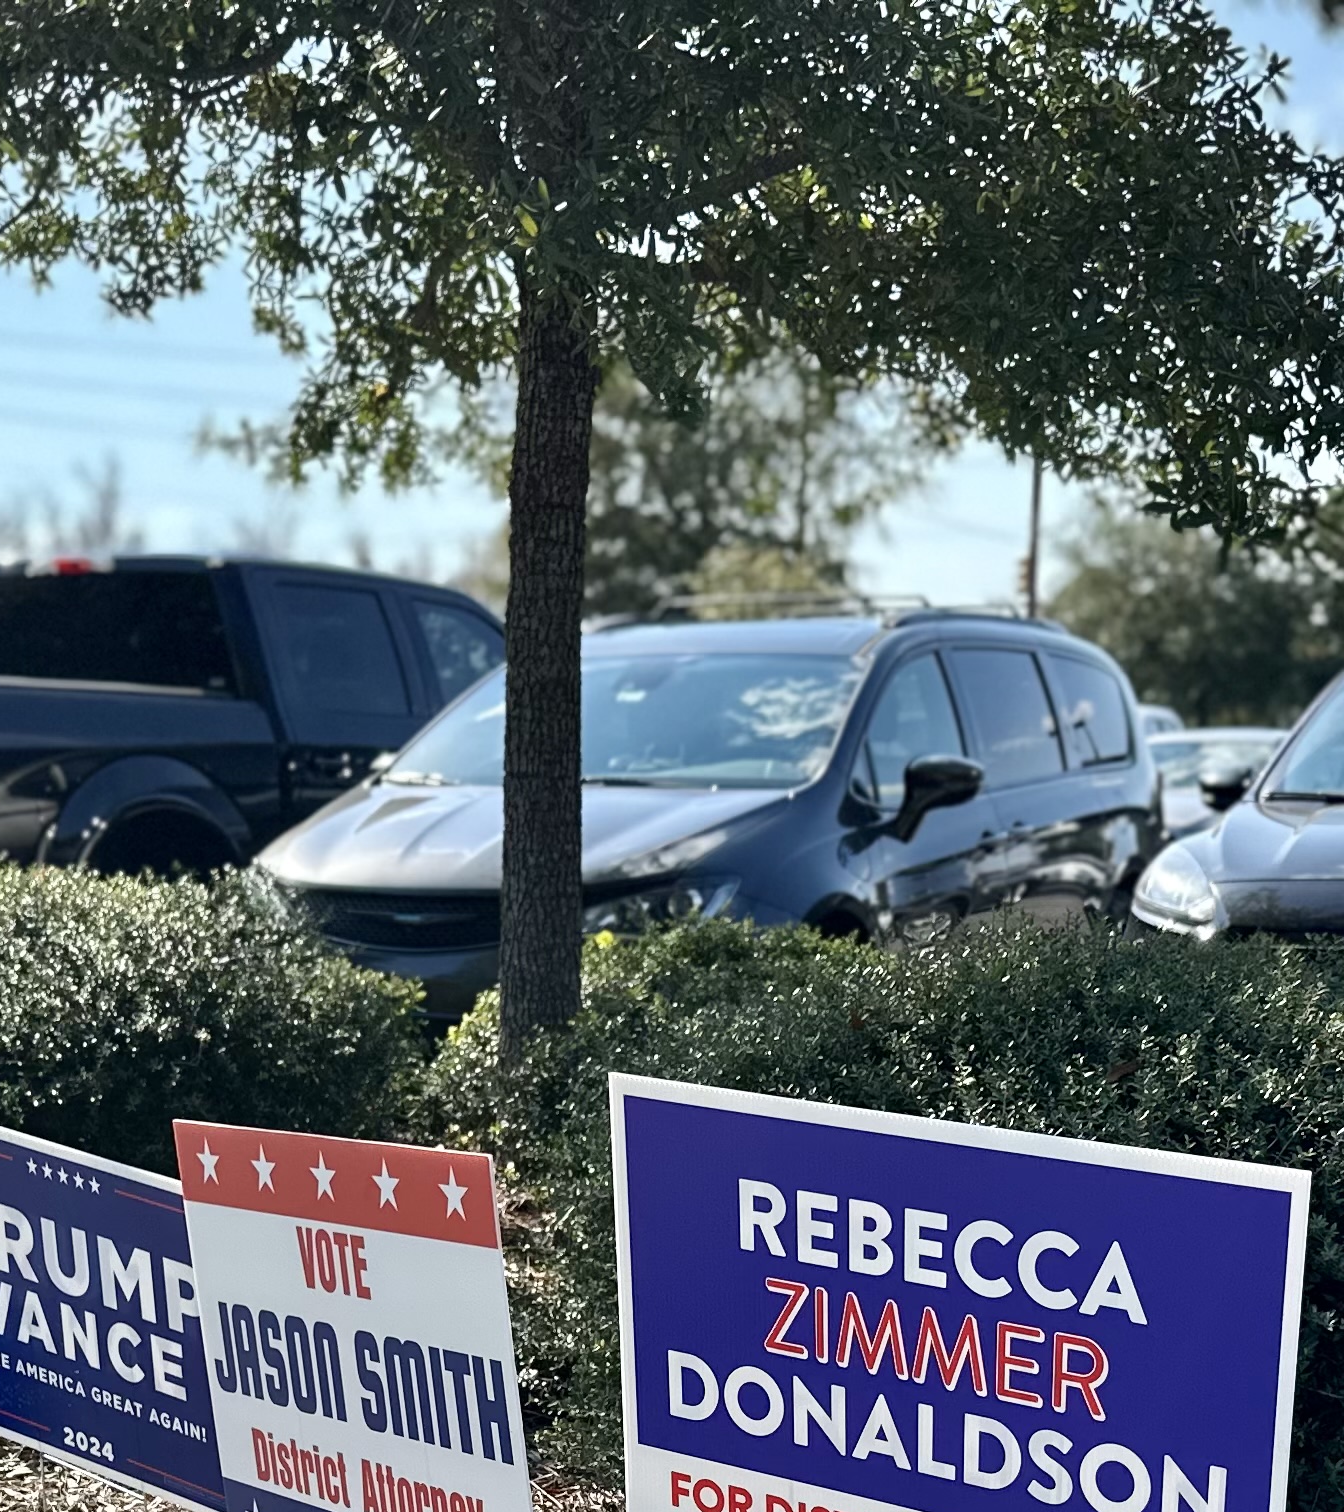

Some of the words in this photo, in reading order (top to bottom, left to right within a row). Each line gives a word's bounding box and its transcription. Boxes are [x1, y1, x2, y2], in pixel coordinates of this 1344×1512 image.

[295, 1226, 372, 1301] VOTE
[737, 1177, 1148, 1326] REBECCA
[214, 1301, 348, 1424] JASON
[353, 1330, 515, 1466] SMITH
[763, 1276, 1110, 1422] ZIMMER
[15, 1359, 87, 1398] AMERICA
[90, 1386, 144, 1418] GREAT
[148, 1408, 208, 1444] AGAIN!
[63, 1426, 116, 1463] 2024
[251, 1427, 350, 1510] District
